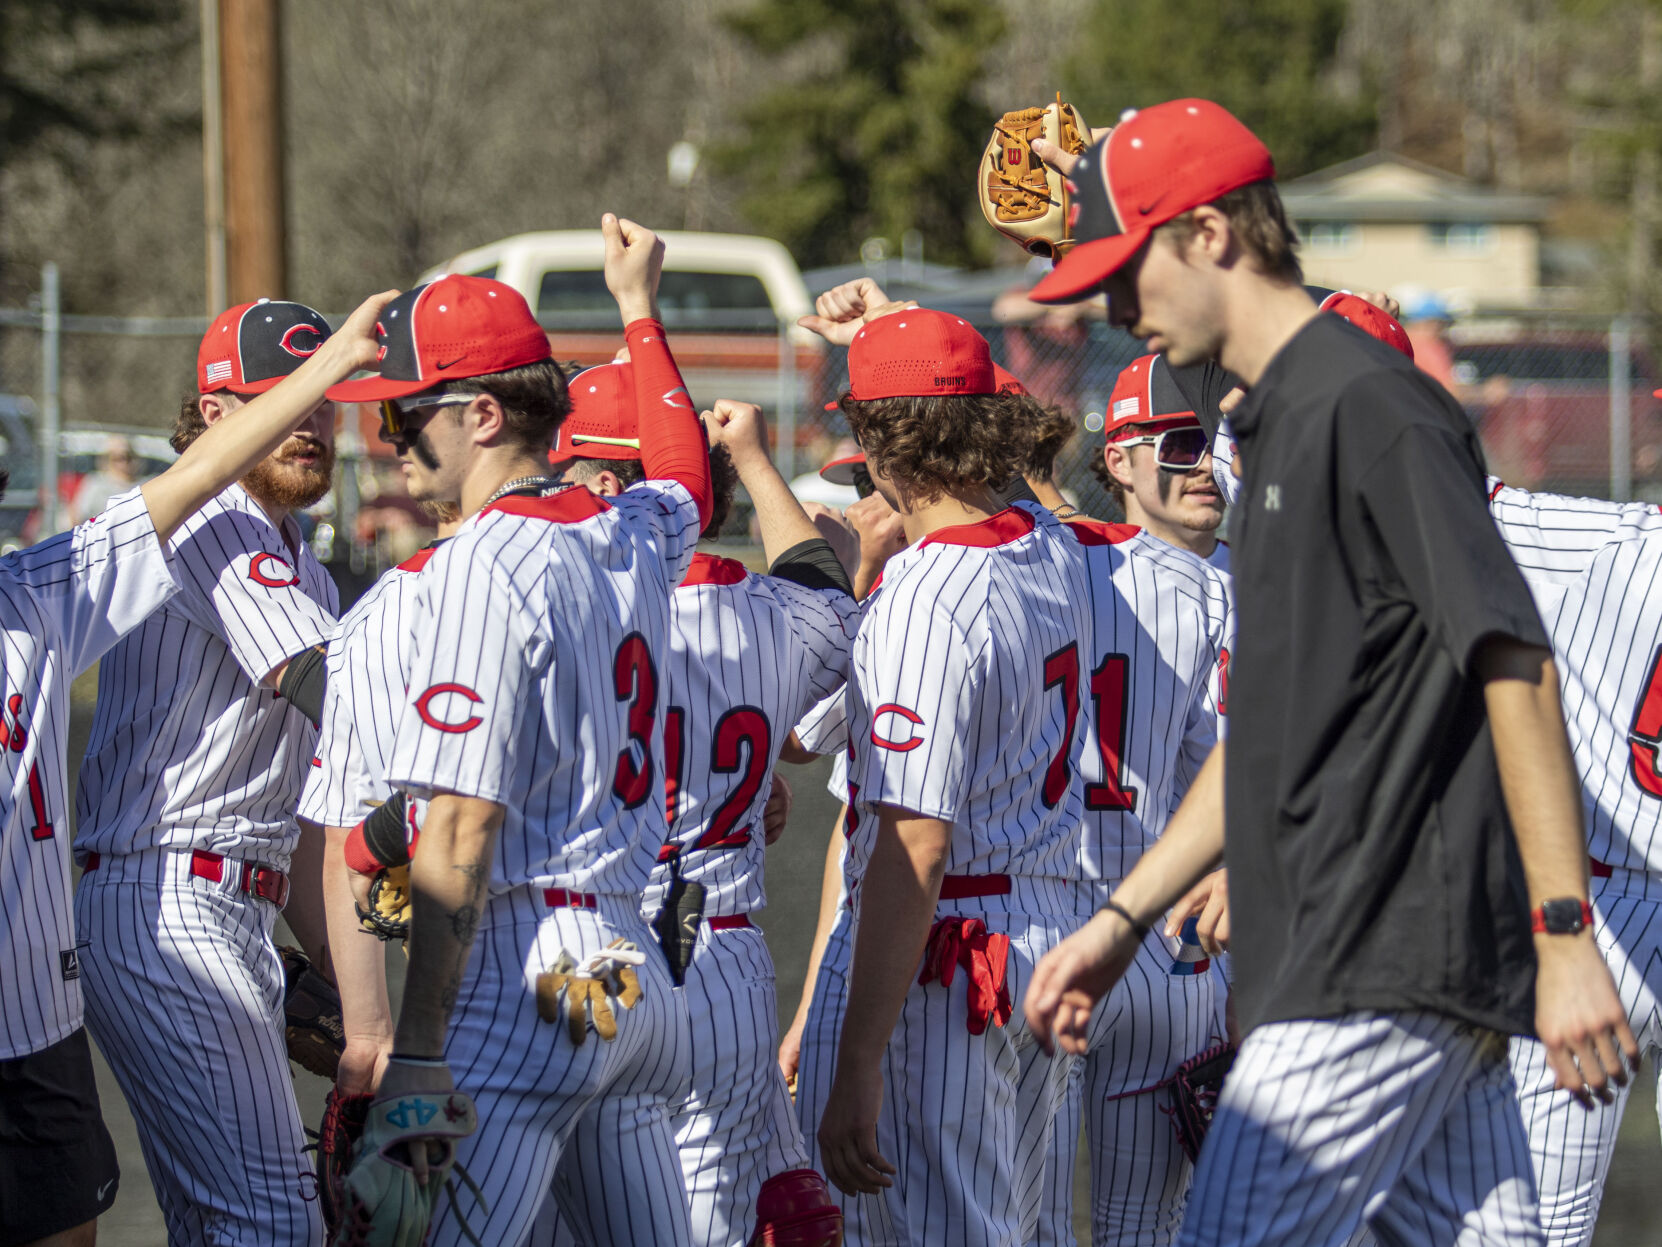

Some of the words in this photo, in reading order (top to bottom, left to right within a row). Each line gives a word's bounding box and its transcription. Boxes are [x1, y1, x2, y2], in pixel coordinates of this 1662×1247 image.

[279, 323, 323, 358] C
[934, 376, 966, 387] BRUINS
[247, 551, 301, 588] C
[412, 682, 485, 734] C
[612, 630, 659, 811] 3
[870, 702, 925, 753] C
[1041, 639, 1080, 811] 7
